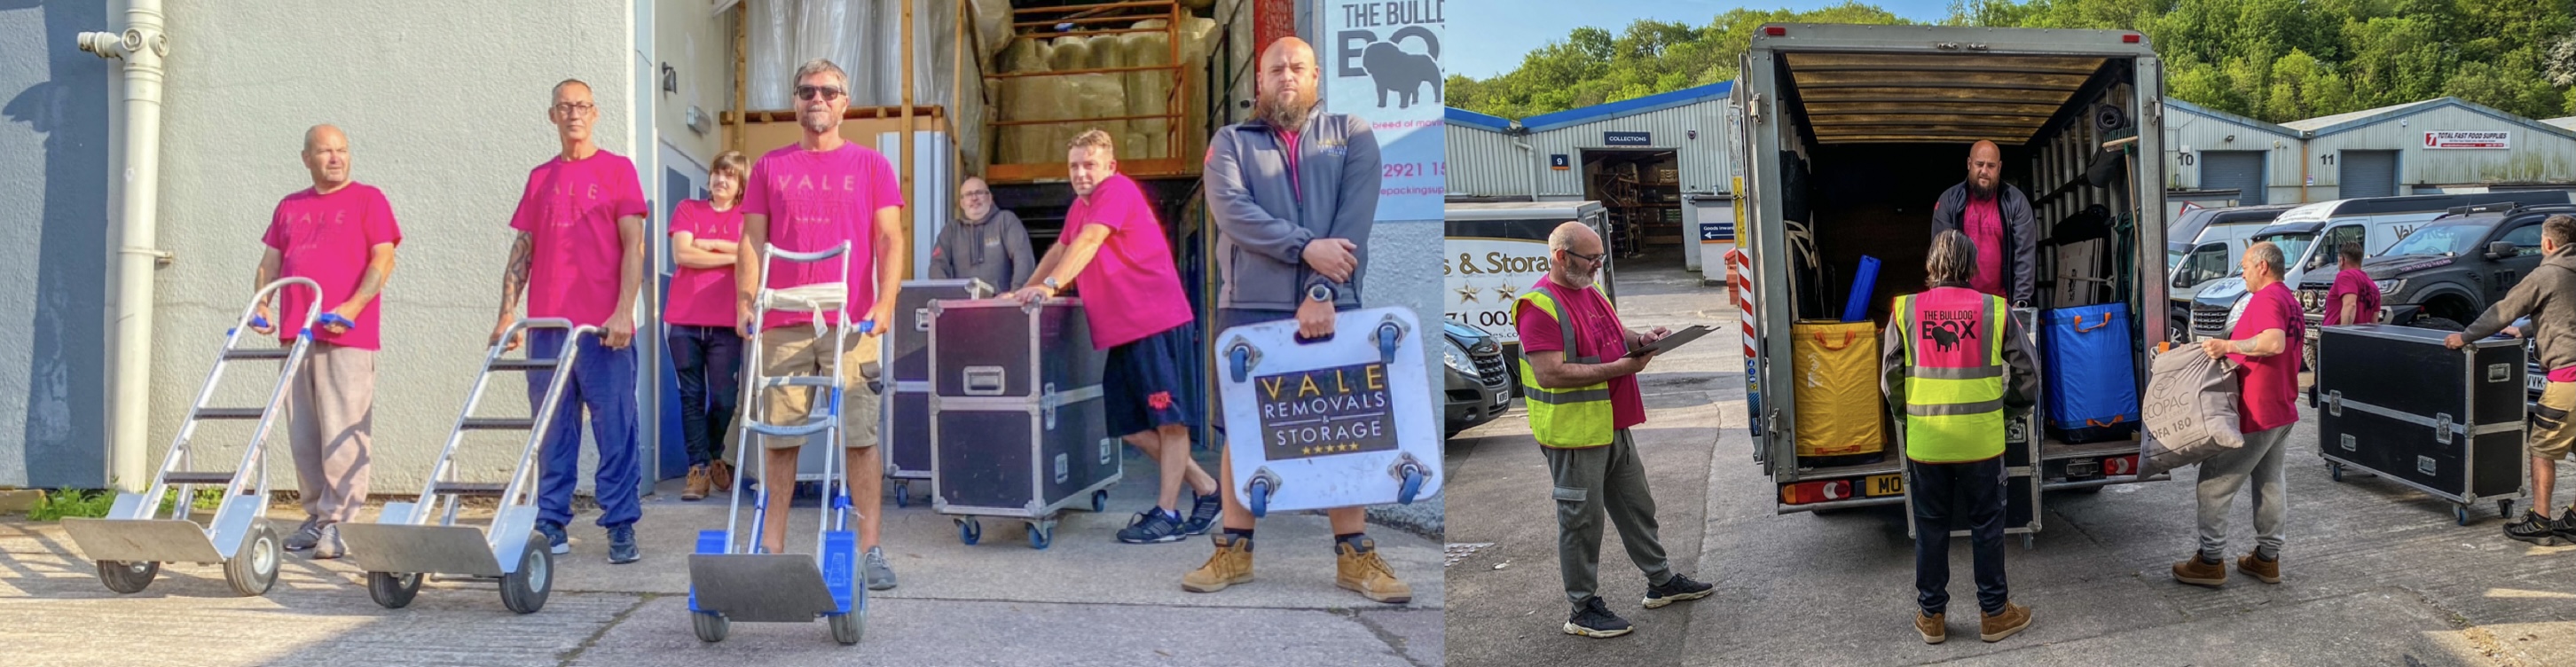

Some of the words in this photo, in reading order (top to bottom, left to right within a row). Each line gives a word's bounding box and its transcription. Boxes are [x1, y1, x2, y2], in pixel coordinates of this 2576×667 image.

[1342, 3, 1380, 28] THE
[1372, 121, 1402, 129] breed
[2177, 154, 2194, 166] 10
[2321, 154, 2334, 165] 11
[1384, 162, 1422, 177] 2921
[778, 174, 854, 192] VALE
[1459, 252, 1485, 275] &
[1486, 251, 1552, 274] Stora
[1924, 310, 1937, 320] THE
[1940, 310, 1973, 320] BULLDOG
[1922, 321, 1976, 340] BOX
[1261, 365, 1384, 401] VALE
[1265, 391, 1386, 420] REMOVALS
[2144, 391, 2189, 421] ECOPAC
[1323, 415, 1330, 424] &
[1276, 420, 1382, 446] STORAGE
[2148, 428, 2171, 442] SOFA
[2172, 417, 2192, 433] 180
[1879, 476, 1905, 494] MO
